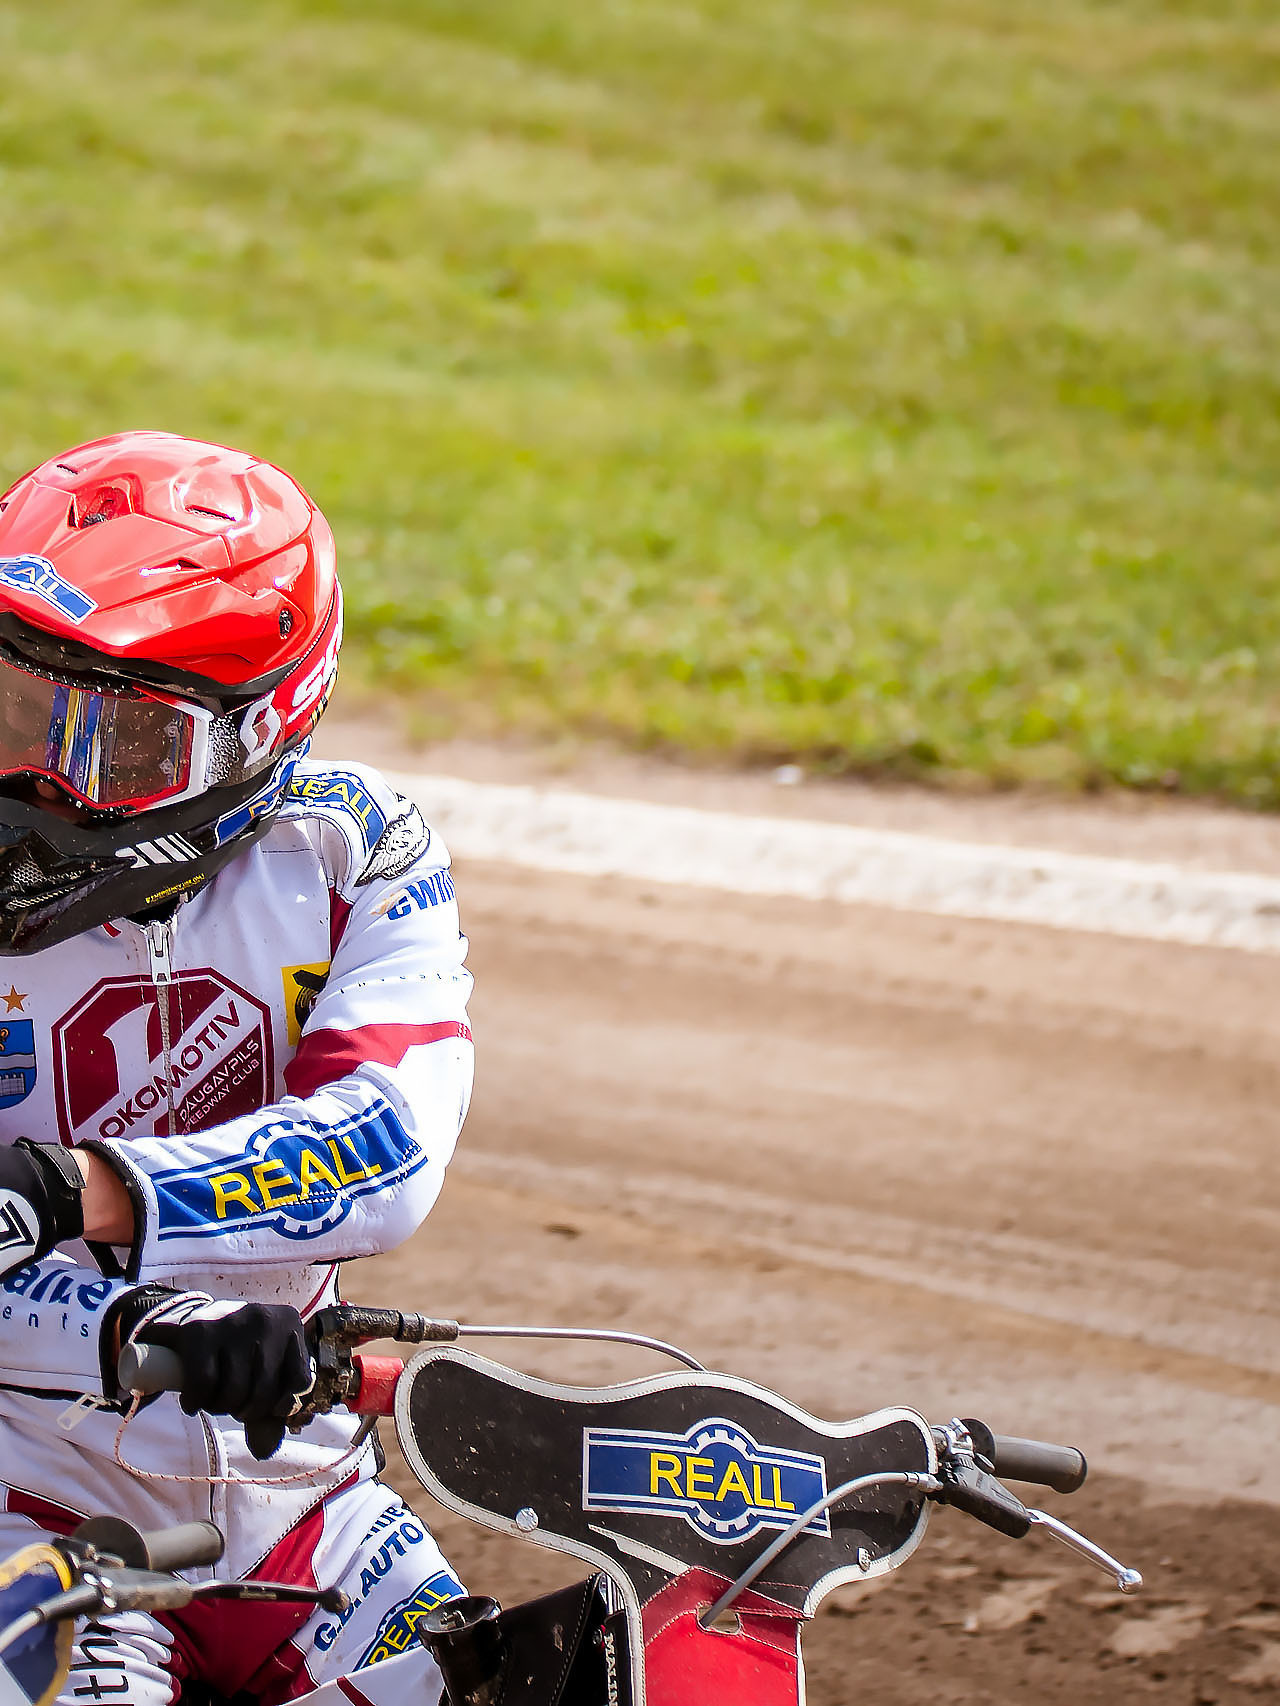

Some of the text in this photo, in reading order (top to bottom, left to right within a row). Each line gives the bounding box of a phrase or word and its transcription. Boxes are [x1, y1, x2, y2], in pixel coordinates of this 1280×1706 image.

[179, 1039, 259, 1122] DAUGAVPILS
[232, 1058, 261, 1086] CLUB
[208, 1134, 382, 1220] REALL
[648, 1451, 796, 1512] REALL
[360, 1522, 424, 1598] AUTO
